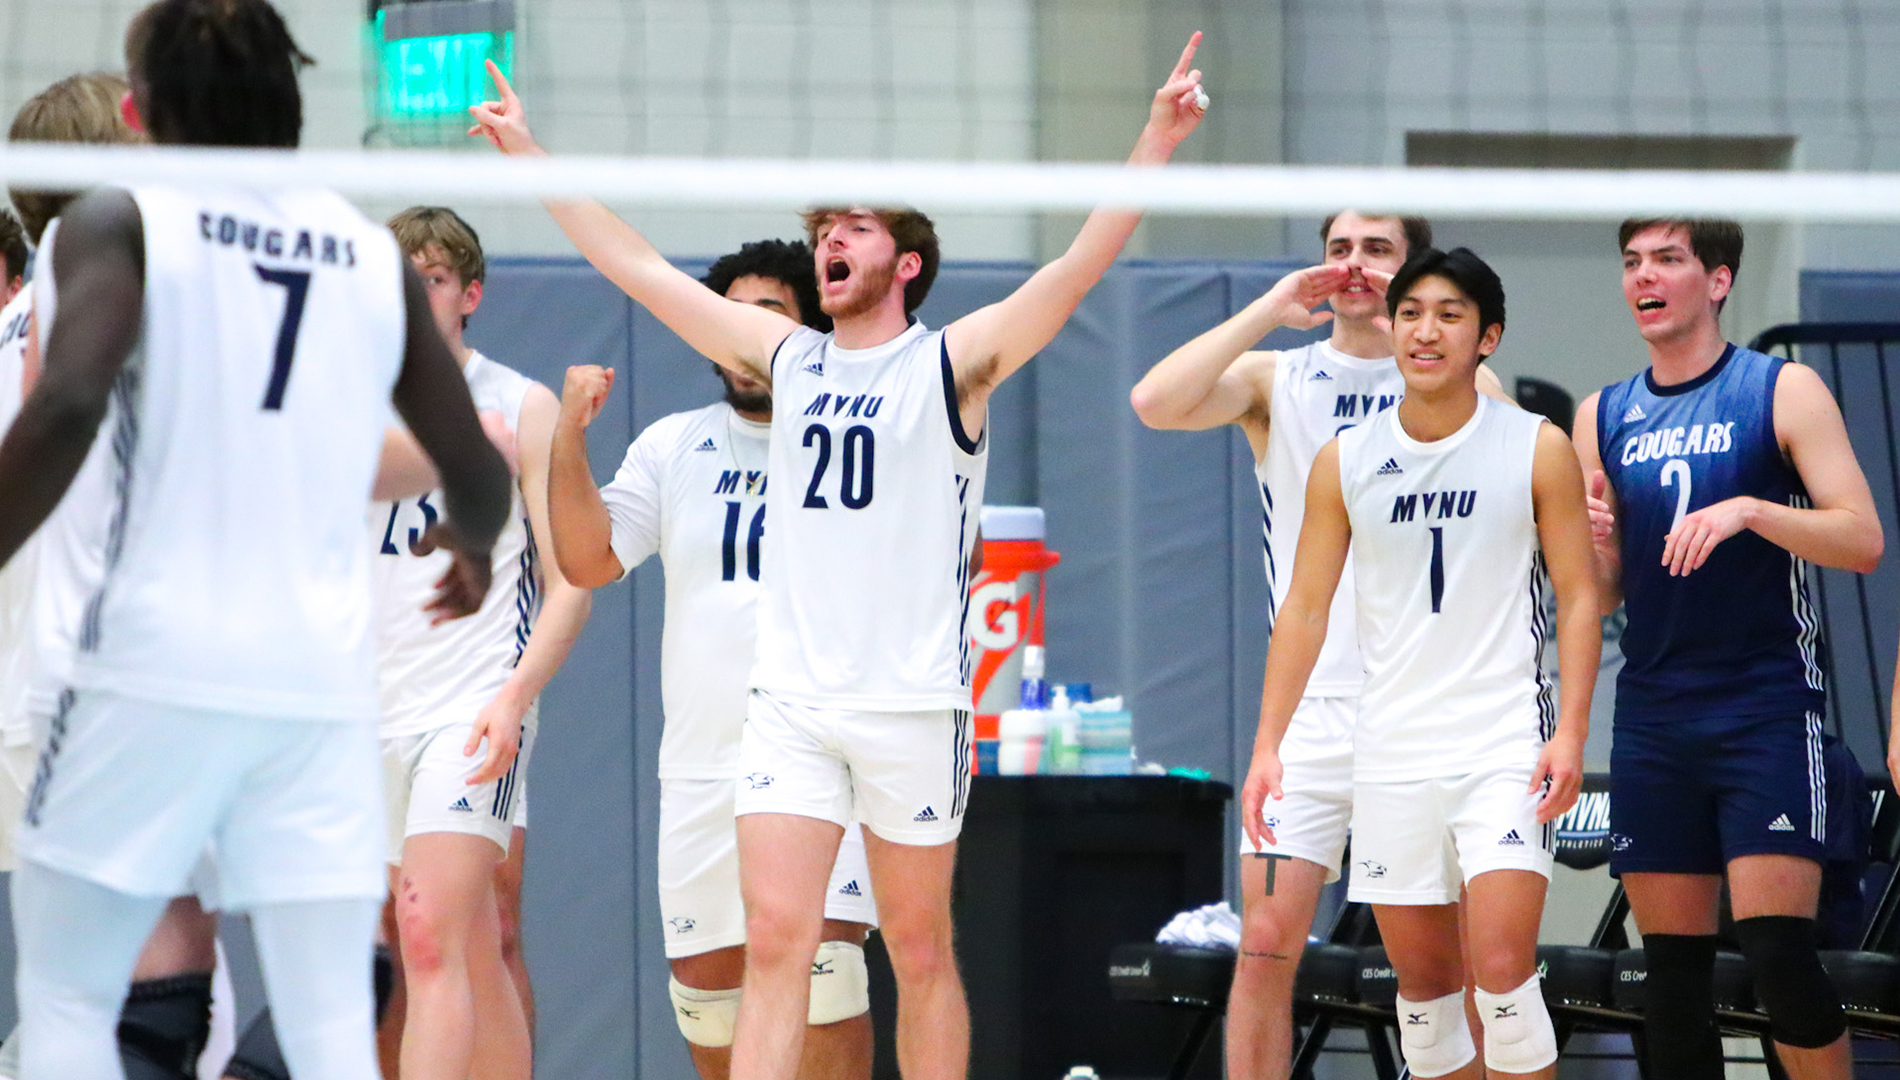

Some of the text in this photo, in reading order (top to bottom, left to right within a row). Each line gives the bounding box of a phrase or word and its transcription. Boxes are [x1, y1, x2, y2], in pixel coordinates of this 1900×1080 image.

[200, 212, 356, 268] COUGARS
[253, 264, 311, 410] 7
[803, 392, 884, 418] MVNU
[1333, 394, 1404, 417] MVN
[802, 423, 875, 510] 20
[1621, 422, 1735, 466] COUGARS
[1377, 467, 1403, 475] adidas
[1390, 490, 1477, 523] MVNU
[1660, 459, 1691, 534] 2
[1429, 527, 1444, 614] 1
[970, 581, 1018, 650] G
[839, 887, 862, 897] adidas
